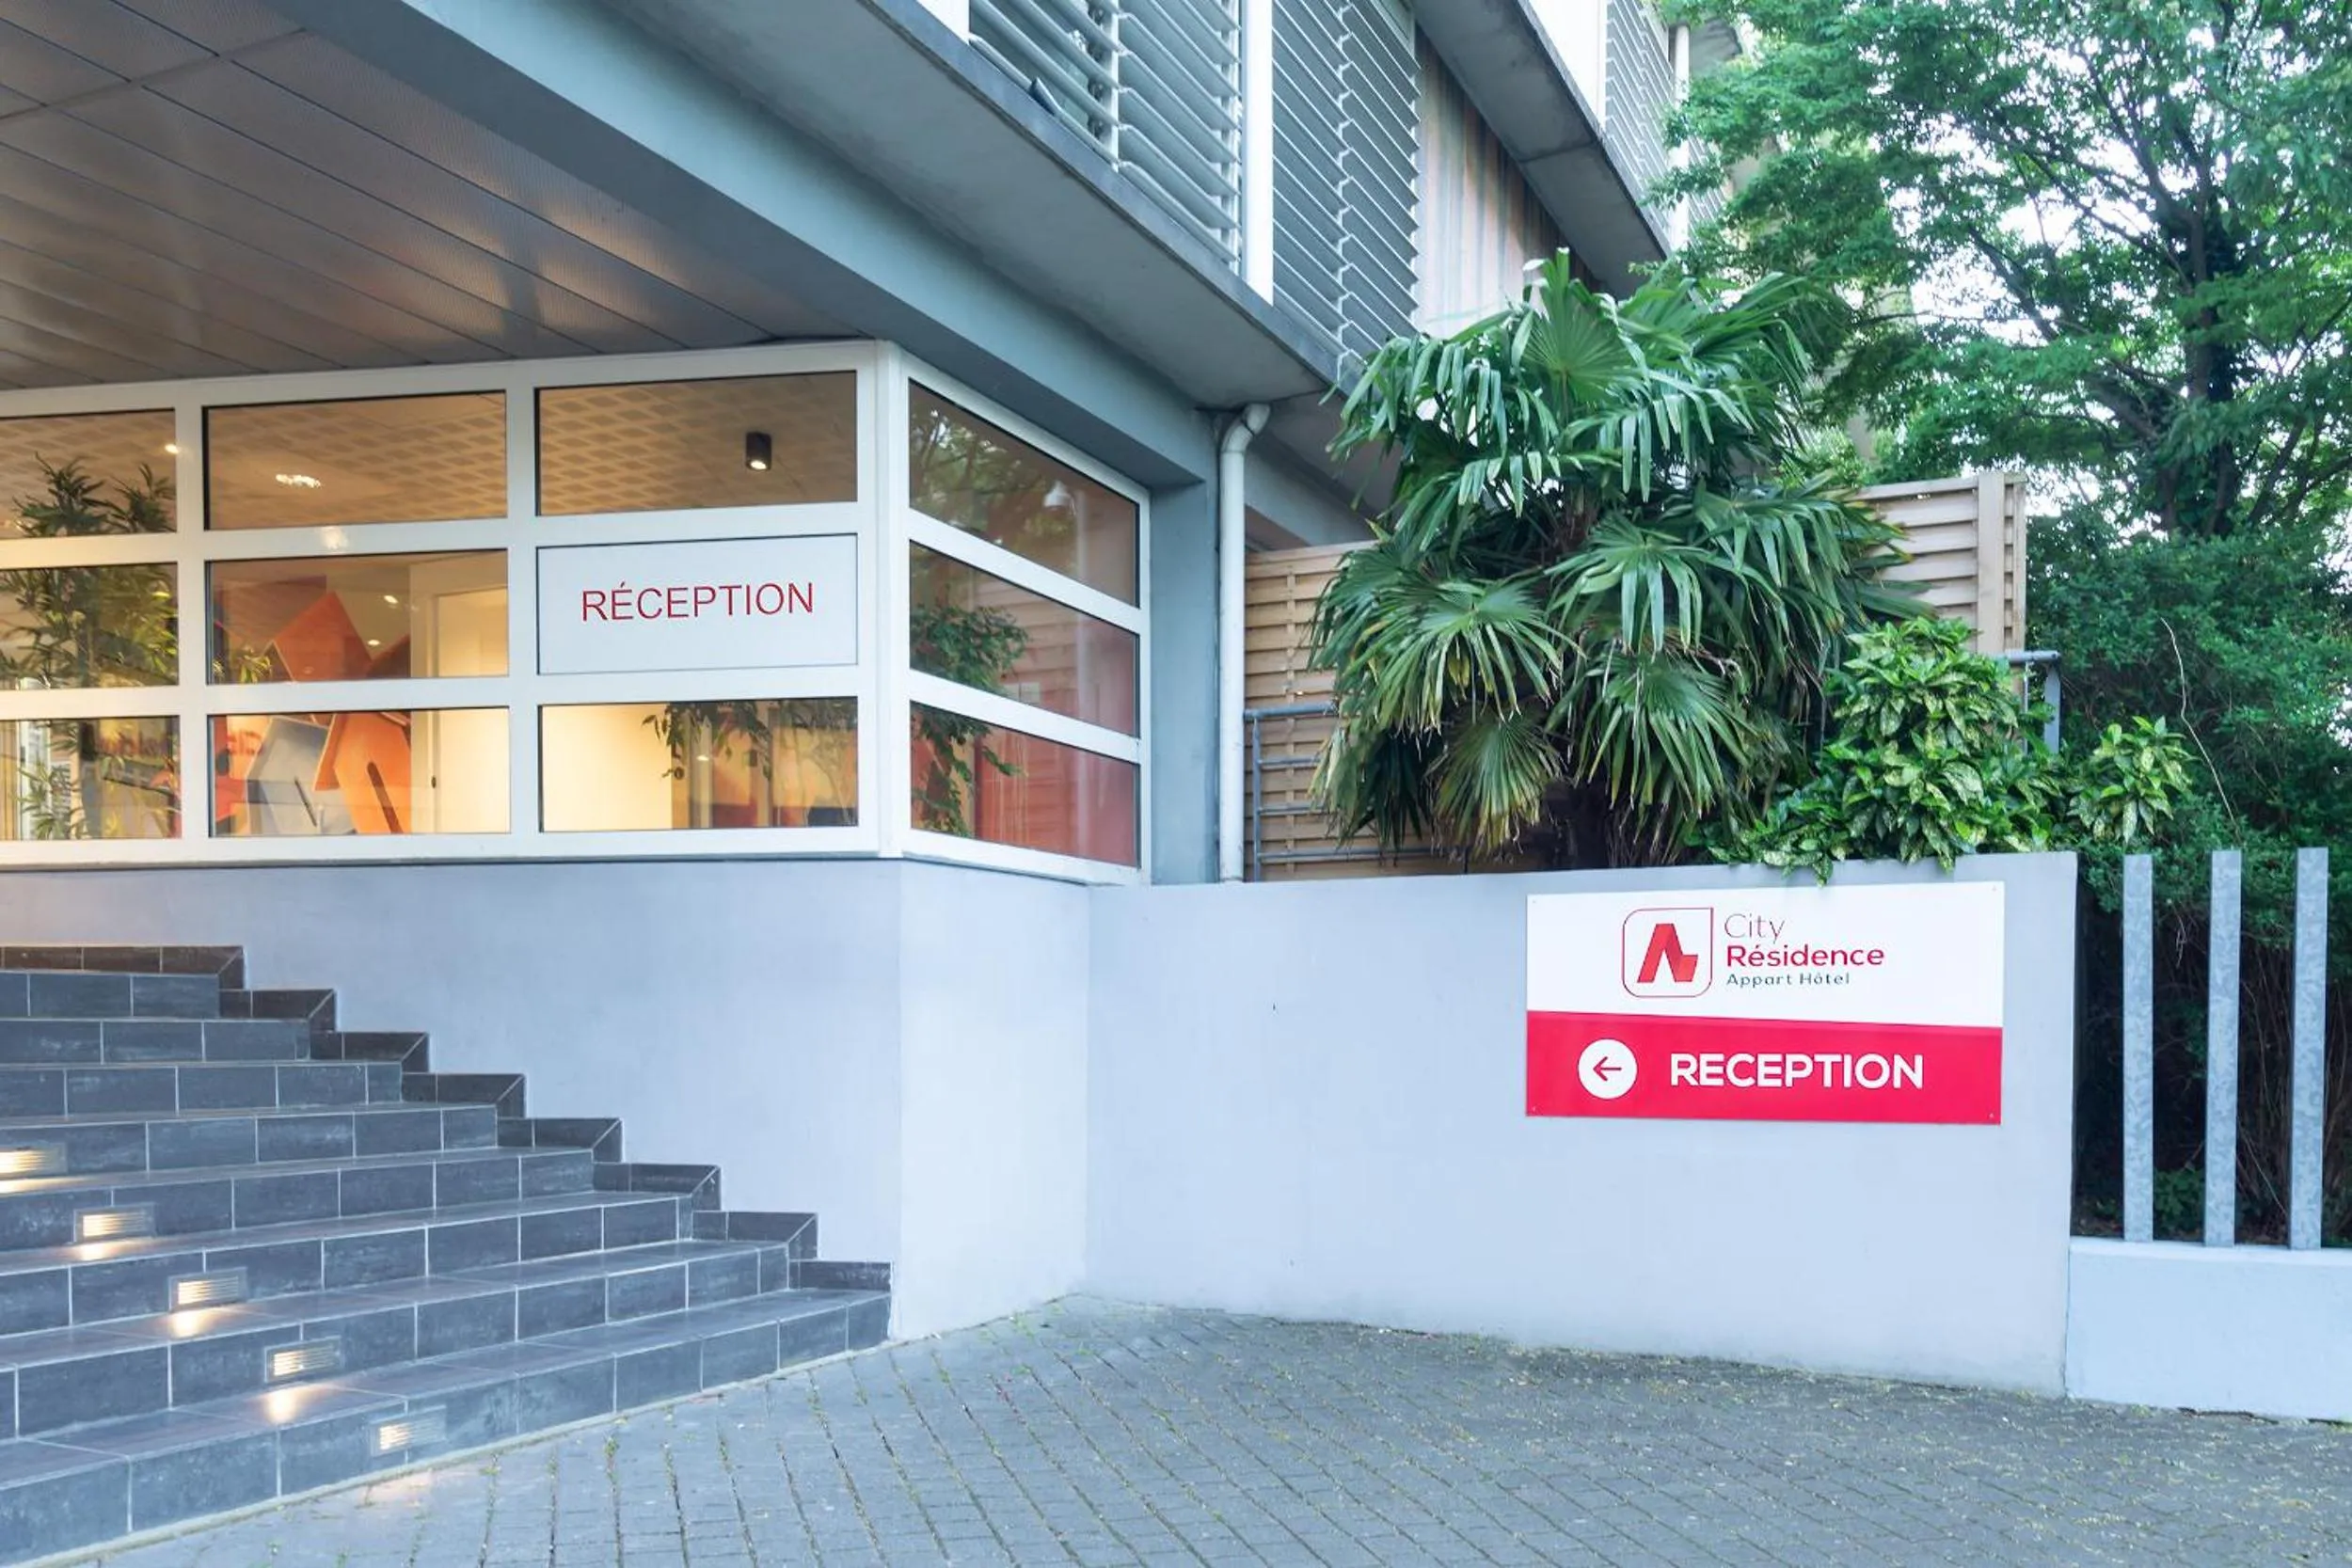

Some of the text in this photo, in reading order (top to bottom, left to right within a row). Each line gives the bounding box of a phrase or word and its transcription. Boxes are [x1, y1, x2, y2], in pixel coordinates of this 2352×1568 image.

[582, 581, 814, 622] RÉCEPTION
[1724, 912, 1786, 943] City
[1726, 943, 1885, 968] Résidence
[1726, 972, 1851, 989] Appart Hôtel
[1670, 1053, 1923, 1089] RECEPTION
